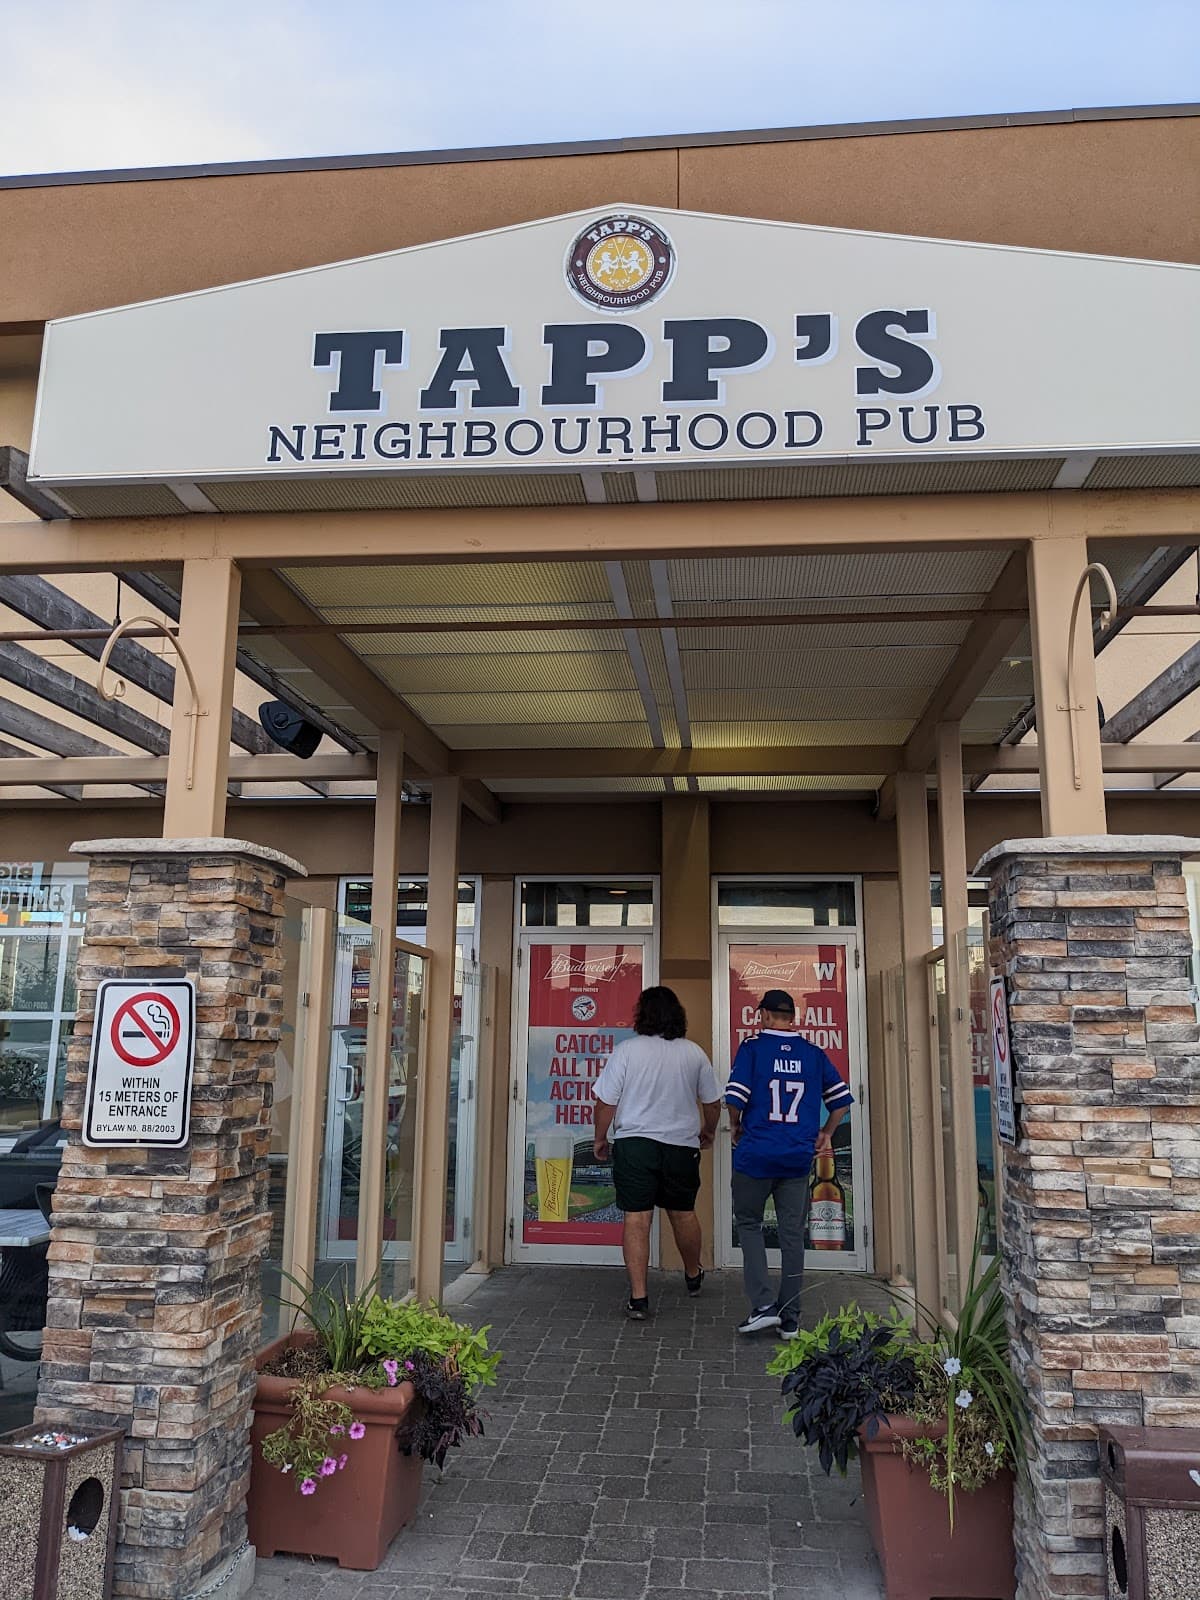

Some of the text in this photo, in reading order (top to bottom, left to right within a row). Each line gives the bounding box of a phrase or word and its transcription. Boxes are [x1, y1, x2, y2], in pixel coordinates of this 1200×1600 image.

[586, 221, 654, 242] TAPP'S
[578, 270, 664, 304] NEIGHBOURHOOD PUB
[312, 309, 934, 412] TAPP'S
[266, 404, 985, 462] NEIGHBOURHOOD PUB
[550, 959, 619, 974] Budweiser
[744, 964, 794, 977] Budweiser
[812, 962, 836, 980] W
[804, 1006, 837, 1026] ALL
[555, 1034, 614, 1054] CATCH
[549, 1057, 608, 1078] ALL TH
[773, 1059, 802, 1074] ALLEN
[122, 1078, 160, 1089] WITHIN
[98, 1091, 179, 1103] 15 METERS OF
[768, 1079, 805, 1123] 17
[108, 1105, 168, 1117] ENTRANCE
[555, 1104, 597, 1125] HER
[96, 1124, 125, 1132] BYLAW
[141, 1124, 176, 1133] 88/2003
